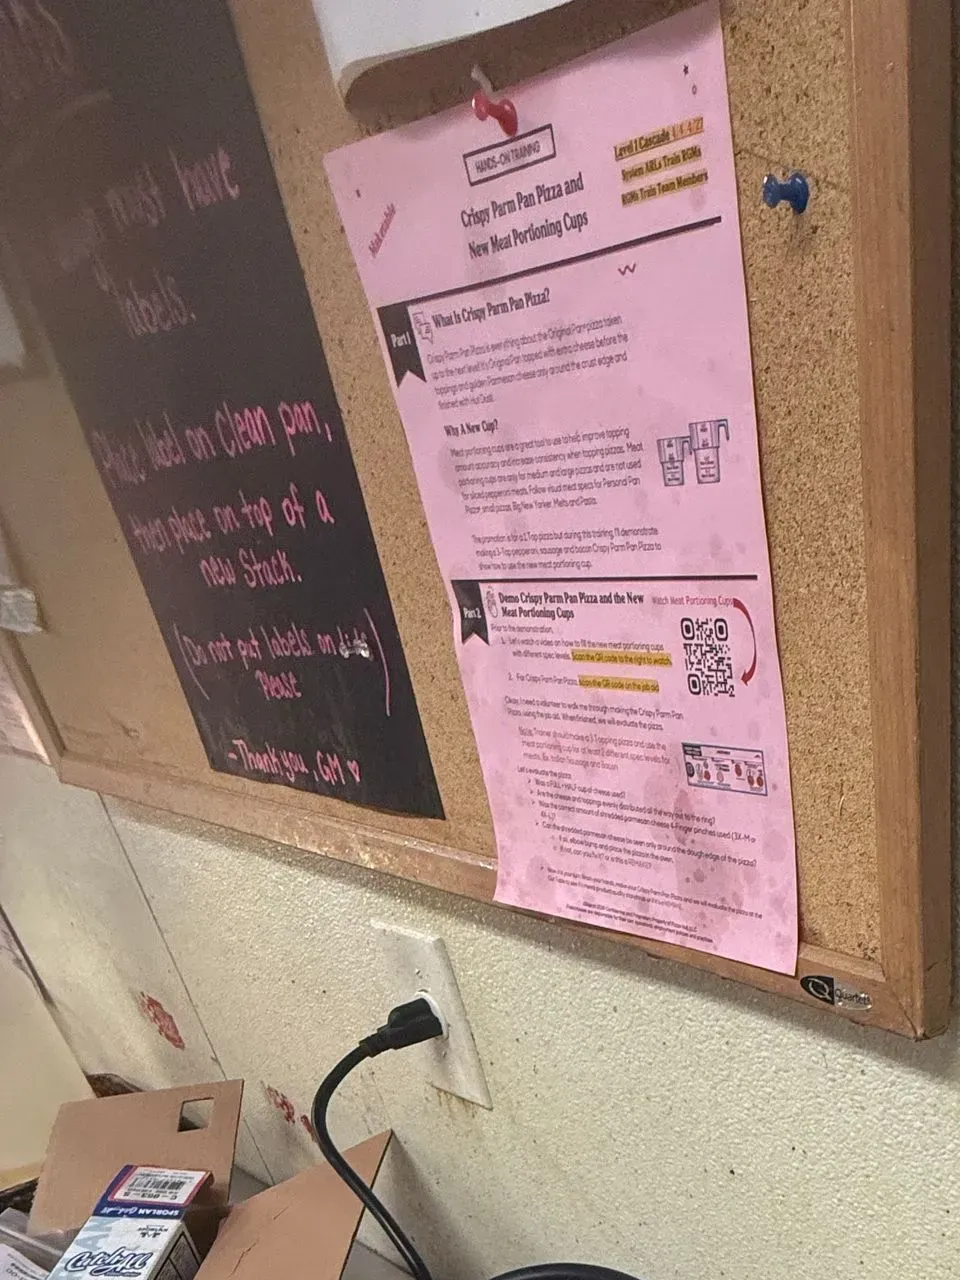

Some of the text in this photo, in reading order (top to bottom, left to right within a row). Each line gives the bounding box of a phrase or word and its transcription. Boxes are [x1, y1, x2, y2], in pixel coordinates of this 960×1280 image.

[614, 140, 634, 158] Level
[638, 128, 670, 149] Cascade
[474, 140, 541, 173] HANDS-ON TRAINING
[662, 152, 681, 168] Train
[167, 143, 242, 215] have
[640, 185, 656, 200] Train
[657, 181, 676, 194] Team
[676, 170, 708, 188] Members
[460, 171, 584, 228] Crispy Parm Pan Pizza and
[468, 212, 588, 259] New Meat Portioning Cups
[432, 288, 550, 329] What Is Crispy Parm Pan Pizza?
[390, 334, 406, 348] Part
[598, 353, 614, 369] edge
[615, 351, 627, 363] and
[185, 425, 217, 460] on
[214, 399, 277, 459] Clean
[278, 400, 333, 457] pan,
[444, 418, 498, 437] Why A New Cup?
[606, 427, 630, 441] topping
[627, 442, 644, 453] Meat
[626, 459, 642, 470] used
[213, 505, 240, 535] on
[238, 489, 274, 537] top
[281, 481, 306, 530] of
[315, 489, 335, 524] a
[593, 544, 610, 554] Crispy
[638, 542, 654, 551] Pizza
[200, 547, 302, 589] new Stack.
[498, 592, 644, 606] Demo Crispy Parm Pan Pizza and the New
[652, 596, 734, 608] Watch Meat Portioning Cups
[463, 608, 482, 618] Part 2
[501, 606, 574, 620] Meat Portioning Cups
[208, 632, 233, 663] not
[237, 627, 262, 670] put
[260, 622, 312, 659] labels
[317, 634, 337, 655] on
[622, 641, 650, 652] portioning
[138, 1208, 180, 1216] SPORLAN
